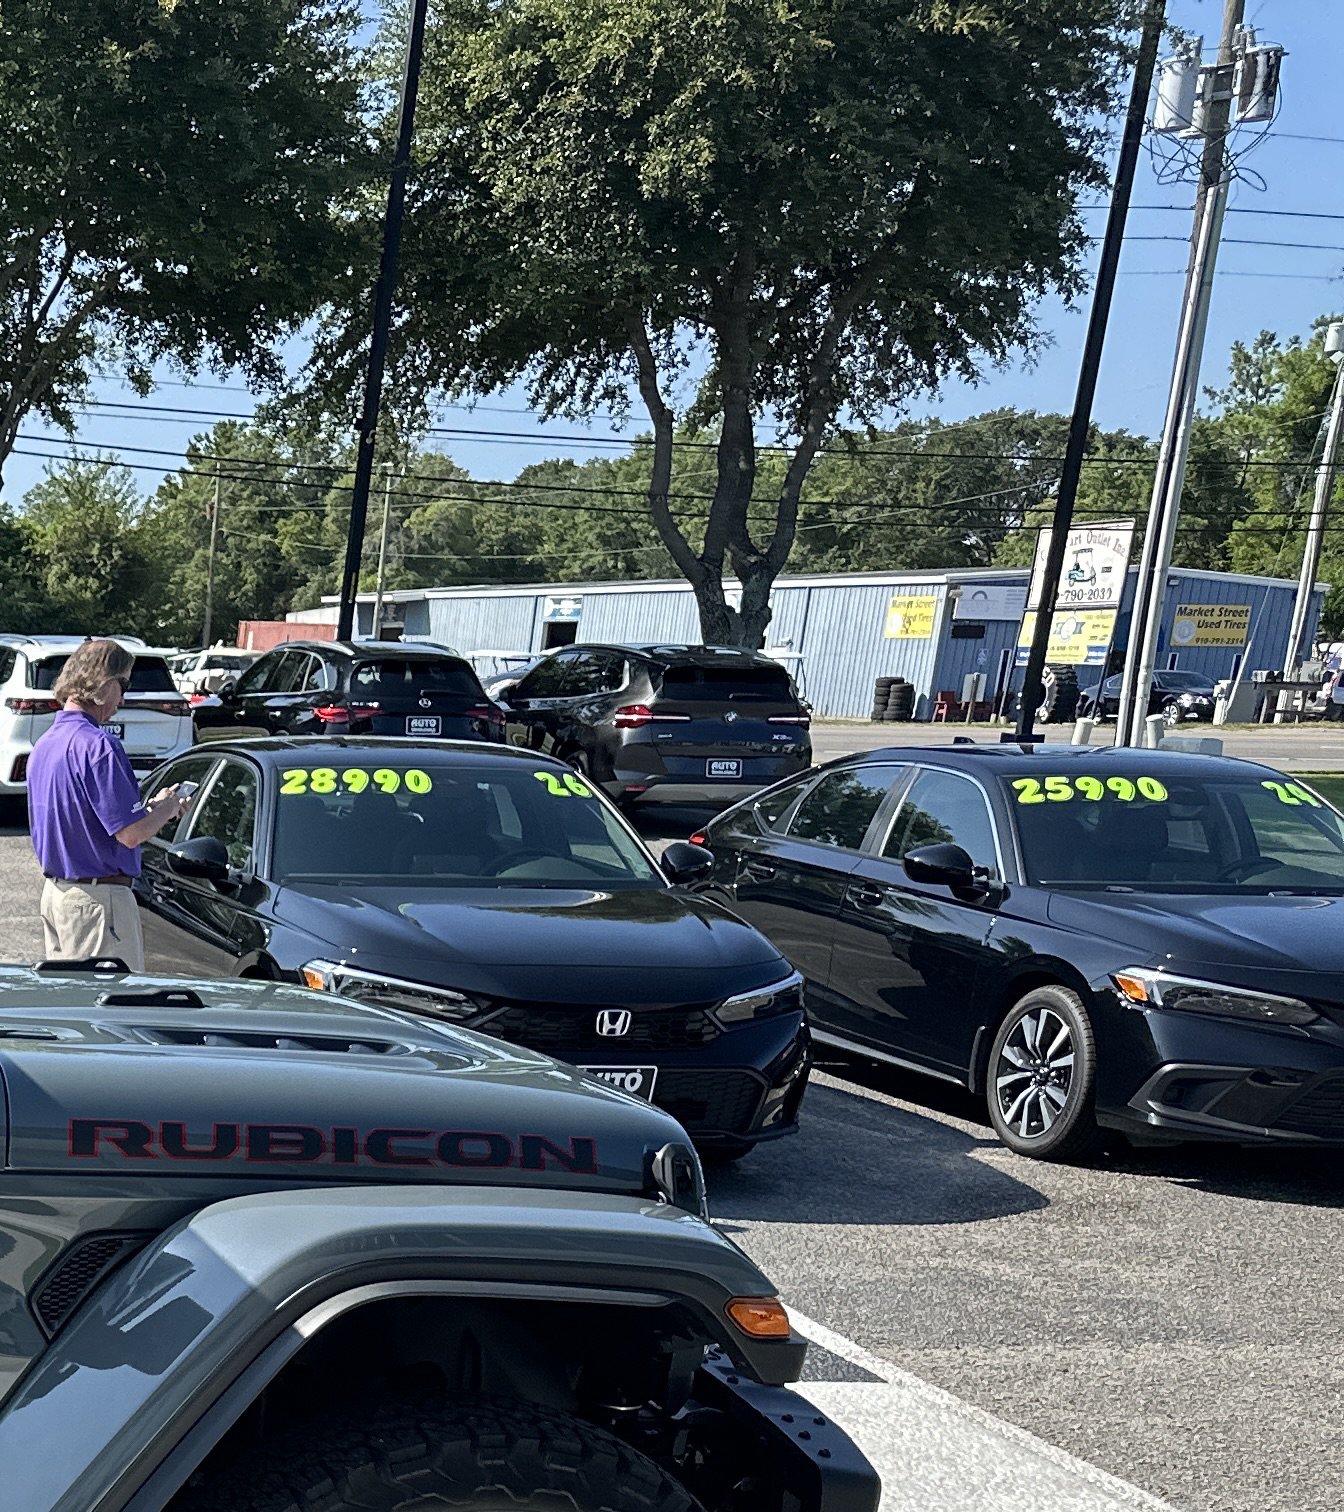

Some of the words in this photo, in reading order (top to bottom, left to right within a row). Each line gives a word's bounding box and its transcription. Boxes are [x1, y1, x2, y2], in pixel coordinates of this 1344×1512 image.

[1176, 606, 1214, 617] Market
[1217, 606, 1250, 617] Street
[1197, 619, 1222, 629] Used
[1224, 619, 1248, 630] Tires
[411, 718, 437, 728] AUTO
[711, 761, 737, 770] AUTO
[280, 768, 433, 795] 28990
[534, 771, 592, 798] 26
[1012, 776, 1168, 804] 25990
[68, 1118, 599, 1174] RUBICON
